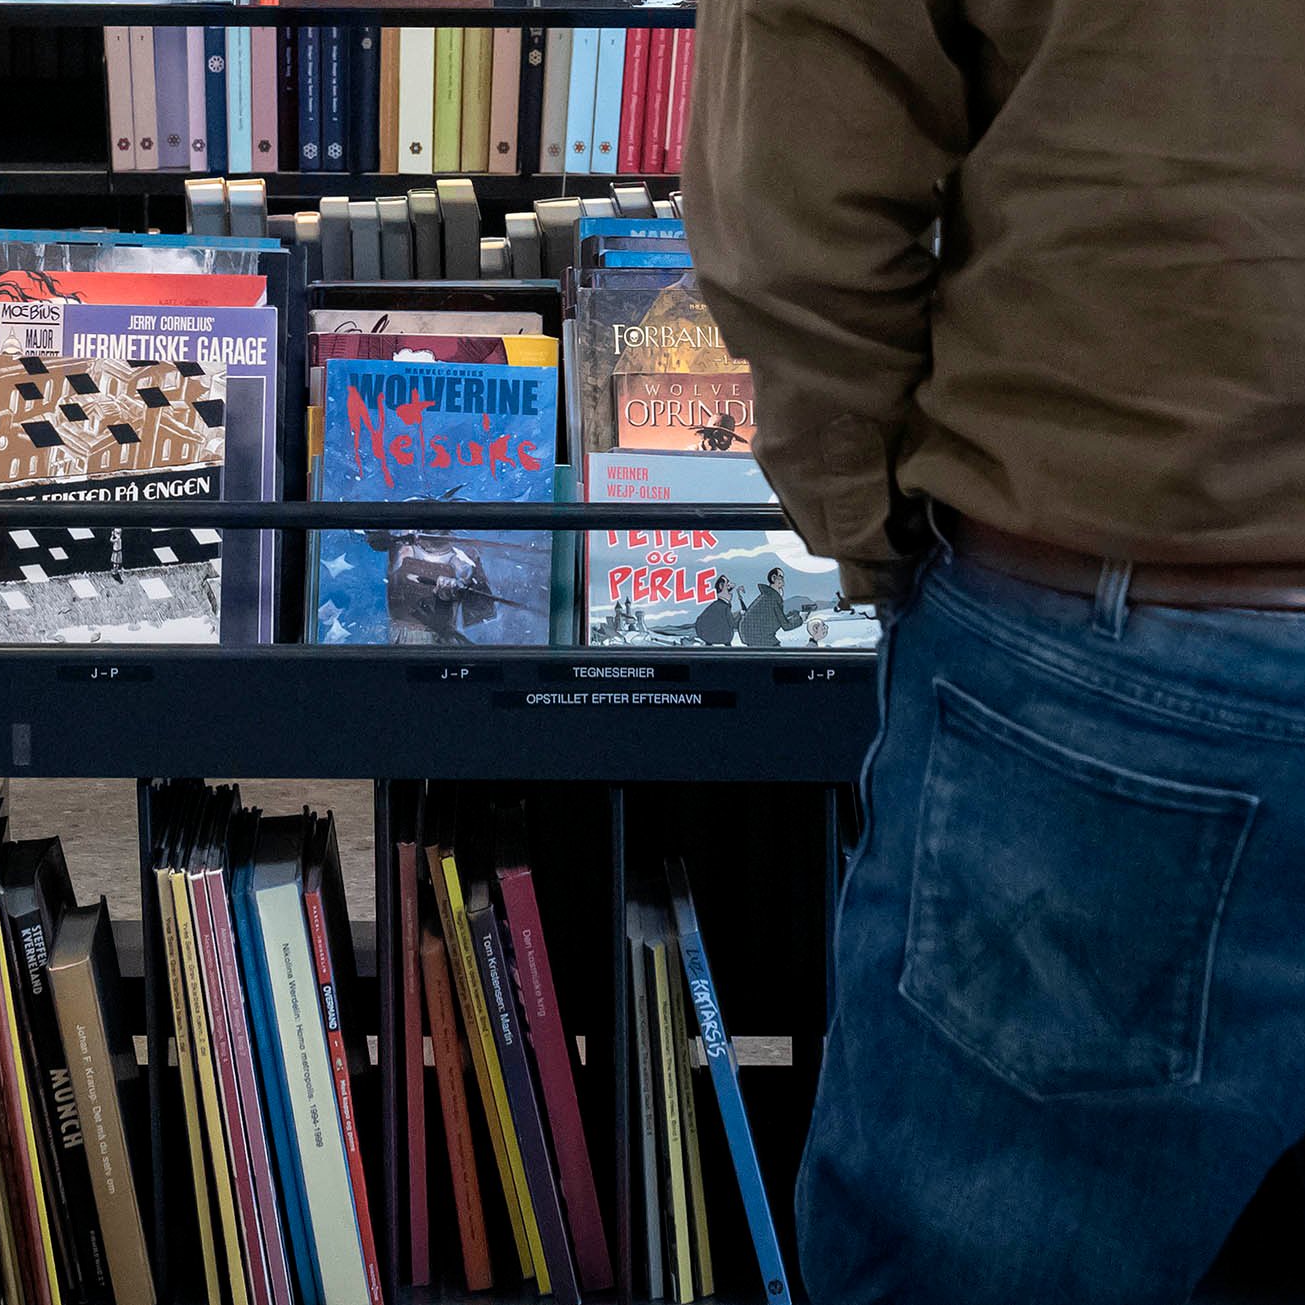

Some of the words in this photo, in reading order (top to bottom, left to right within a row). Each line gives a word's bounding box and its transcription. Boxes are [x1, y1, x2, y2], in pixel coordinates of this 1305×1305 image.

[25, 328, 53, 351] MAJOR
[72, 333, 190, 361] HERMETISKE
[196, 336, 267, 366] GARAGE
[350, 372, 541, 415] WOLVERINE
[607, 467, 649, 481] WERNER
[607, 484, 671, 501] WEJP-OLSEN
[645, 551, 677, 565] OG
[608, 565, 716, 605] PERLE
[572, 666, 655, 678] TEGNESERIER
[525, 693, 588, 705] OPSTILLET
[591, 693, 629, 704] EFTER
[631, 693, 702, 705] EFTERNAVN
[20, 927, 43, 995] KVERNELAND
[31, 924, 49, 968] STEFFEN
[483, 933, 493, 957] Tom
[500, 1013, 513, 1045] Martin
[49, 1068, 83, 1149] MUNCH
